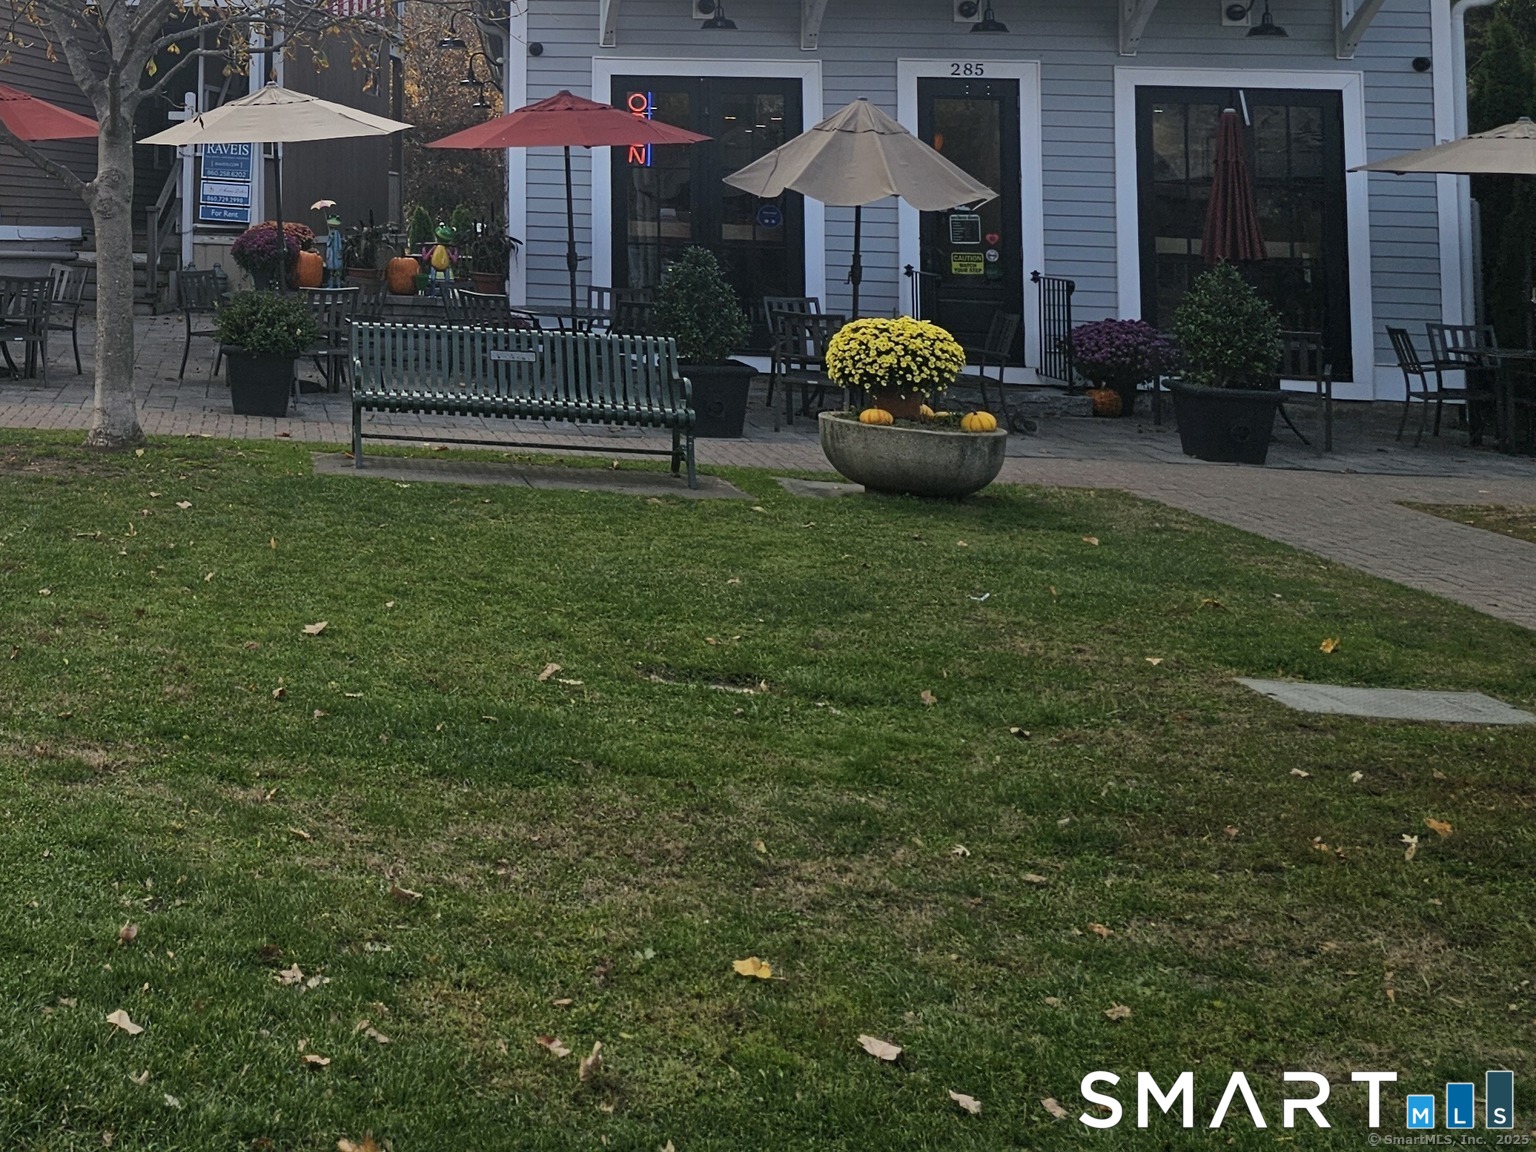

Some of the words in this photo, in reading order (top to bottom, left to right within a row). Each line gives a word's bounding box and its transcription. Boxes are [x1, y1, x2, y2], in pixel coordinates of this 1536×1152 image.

[951, 63, 984, 76] 285
[628, 93, 647, 165] ON
[207, 144, 249, 155] RAVEIS
[211, 209, 222, 217] For
[224, 209, 239, 218] Rent
